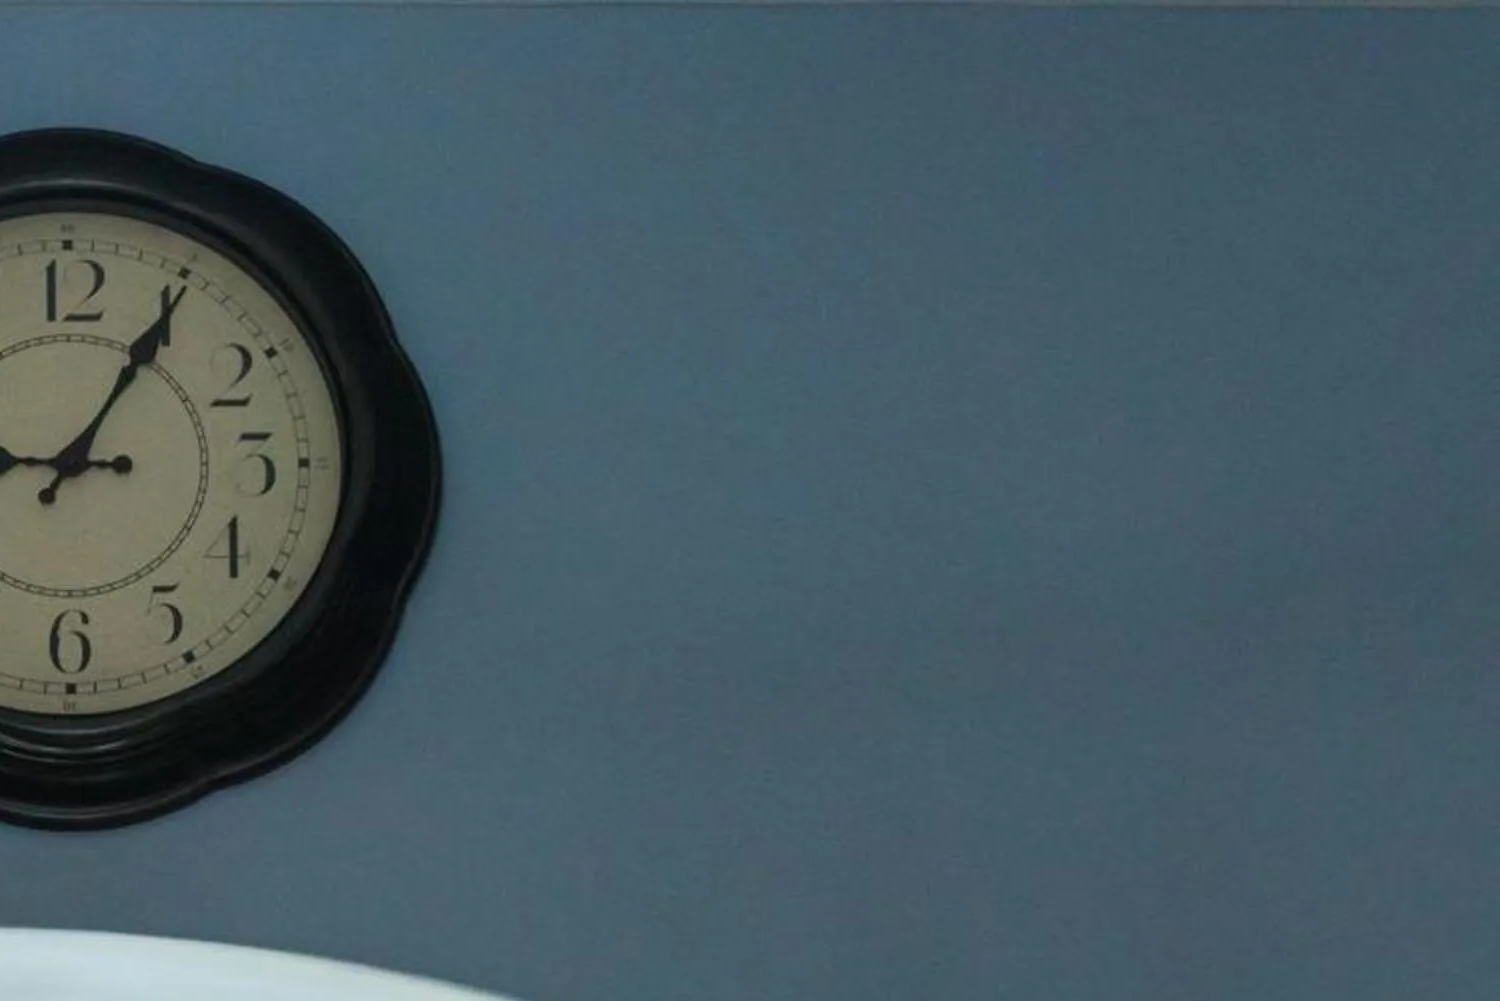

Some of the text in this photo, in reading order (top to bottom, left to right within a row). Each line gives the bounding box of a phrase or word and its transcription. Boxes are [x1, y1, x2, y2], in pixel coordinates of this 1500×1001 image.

[45, 258, 106, 323] 12
[209, 341, 254, 408] 2
[234, 431, 277, 498] 3
[202, 513, 251, 579] 4
[48, 608, 92, 675] 6
[147, 582, 184, 646] 5
